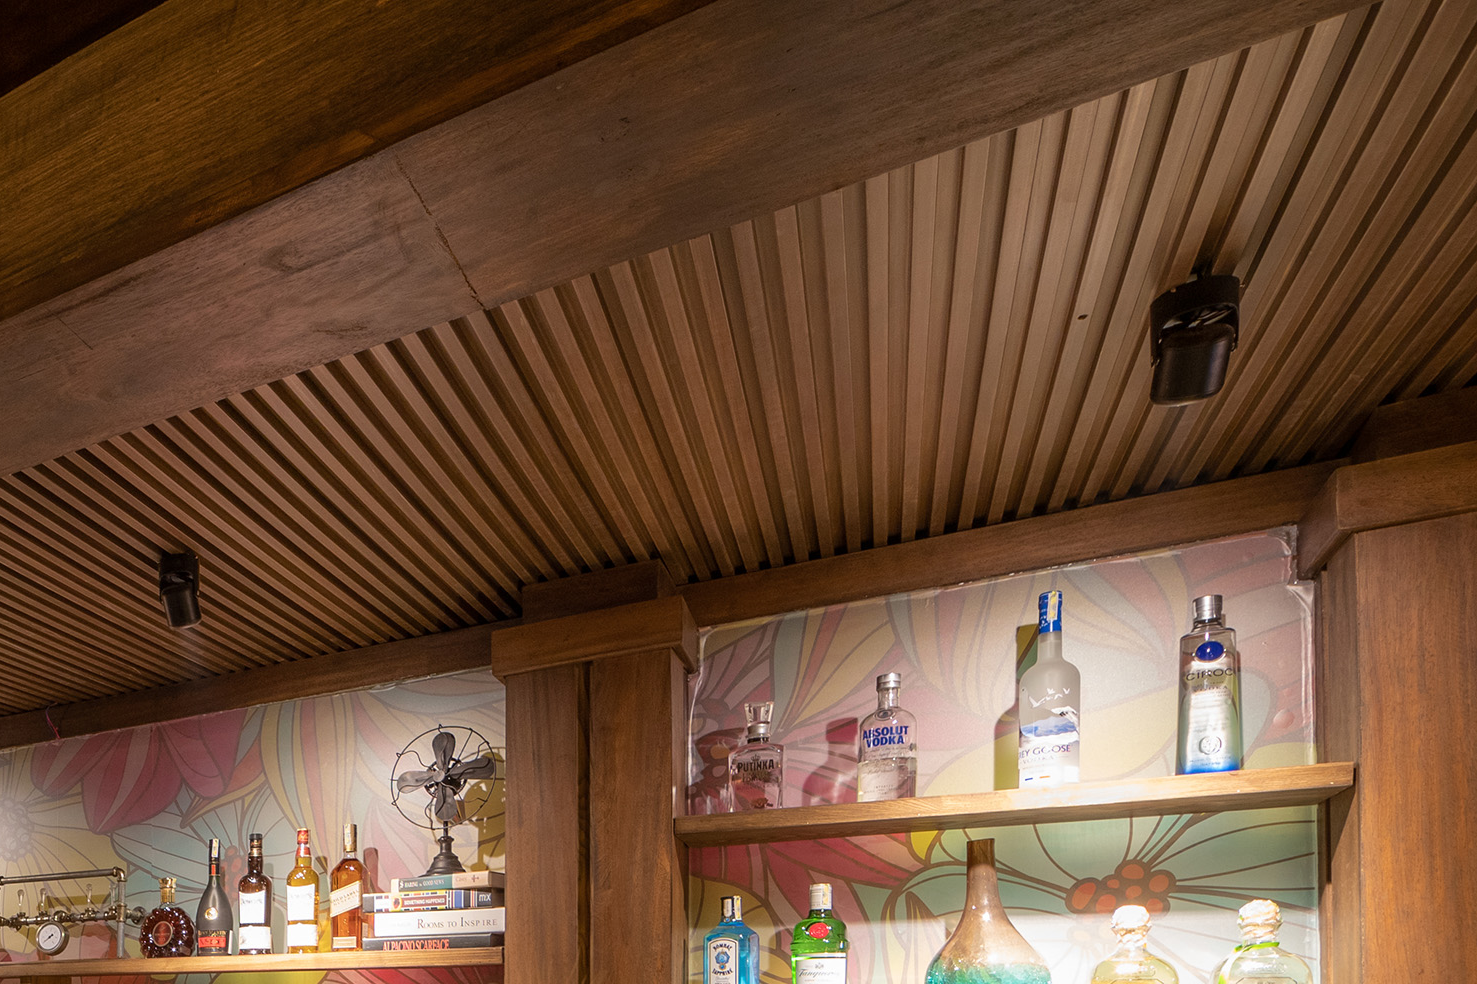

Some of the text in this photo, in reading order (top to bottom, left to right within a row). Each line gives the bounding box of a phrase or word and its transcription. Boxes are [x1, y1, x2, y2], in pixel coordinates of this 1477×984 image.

[862, 725, 909, 740] ABSOLUT
[866, 735, 905, 748] VODKA
[736, 759, 775, 772] PUTINKA
[417, 918, 445, 929] ROOMS
[447, 919, 458, 928] TO
[460, 917, 498, 928] INSPIRE
[712, 942, 734, 951] BOMBAY
[711, 967, 734, 976] SAPPHIRE
